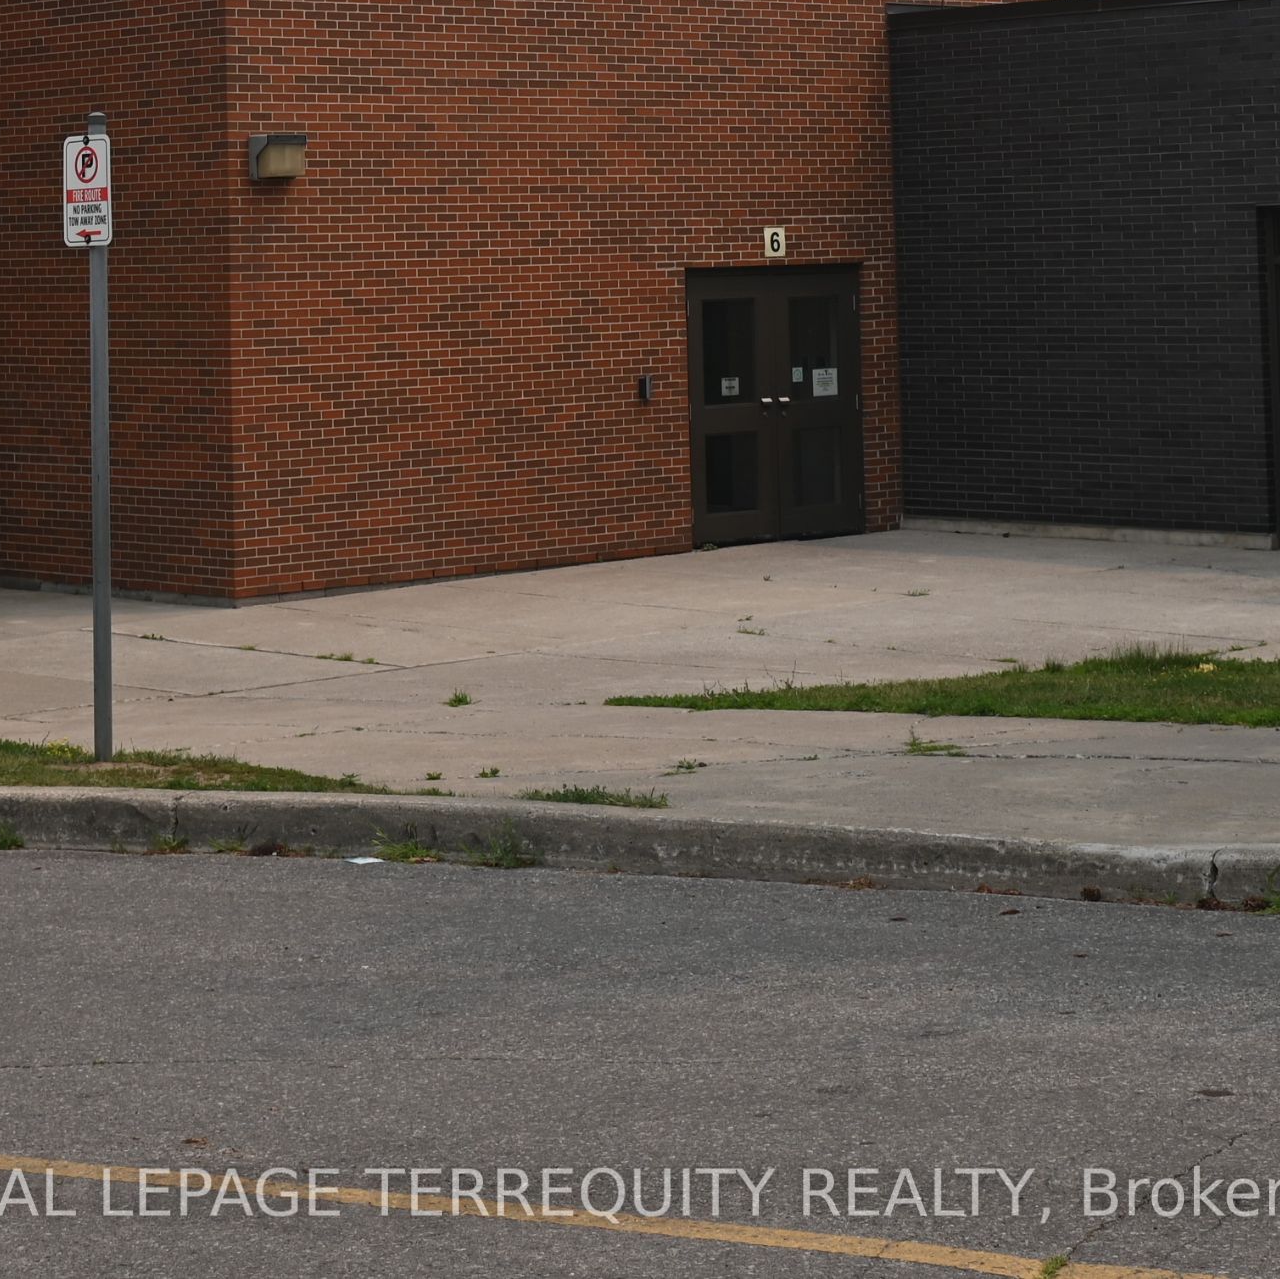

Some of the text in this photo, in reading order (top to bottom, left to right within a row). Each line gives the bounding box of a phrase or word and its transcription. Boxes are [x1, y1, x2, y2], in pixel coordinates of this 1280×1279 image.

[81, 153, 94, 178] P
[72, 189, 102, 202] FIRE ROUTE
[72, 203, 102, 215] NO PARKING
[69, 214, 107, 226] TOW AWAY ZONE
[770, 231, 780, 252] 6
